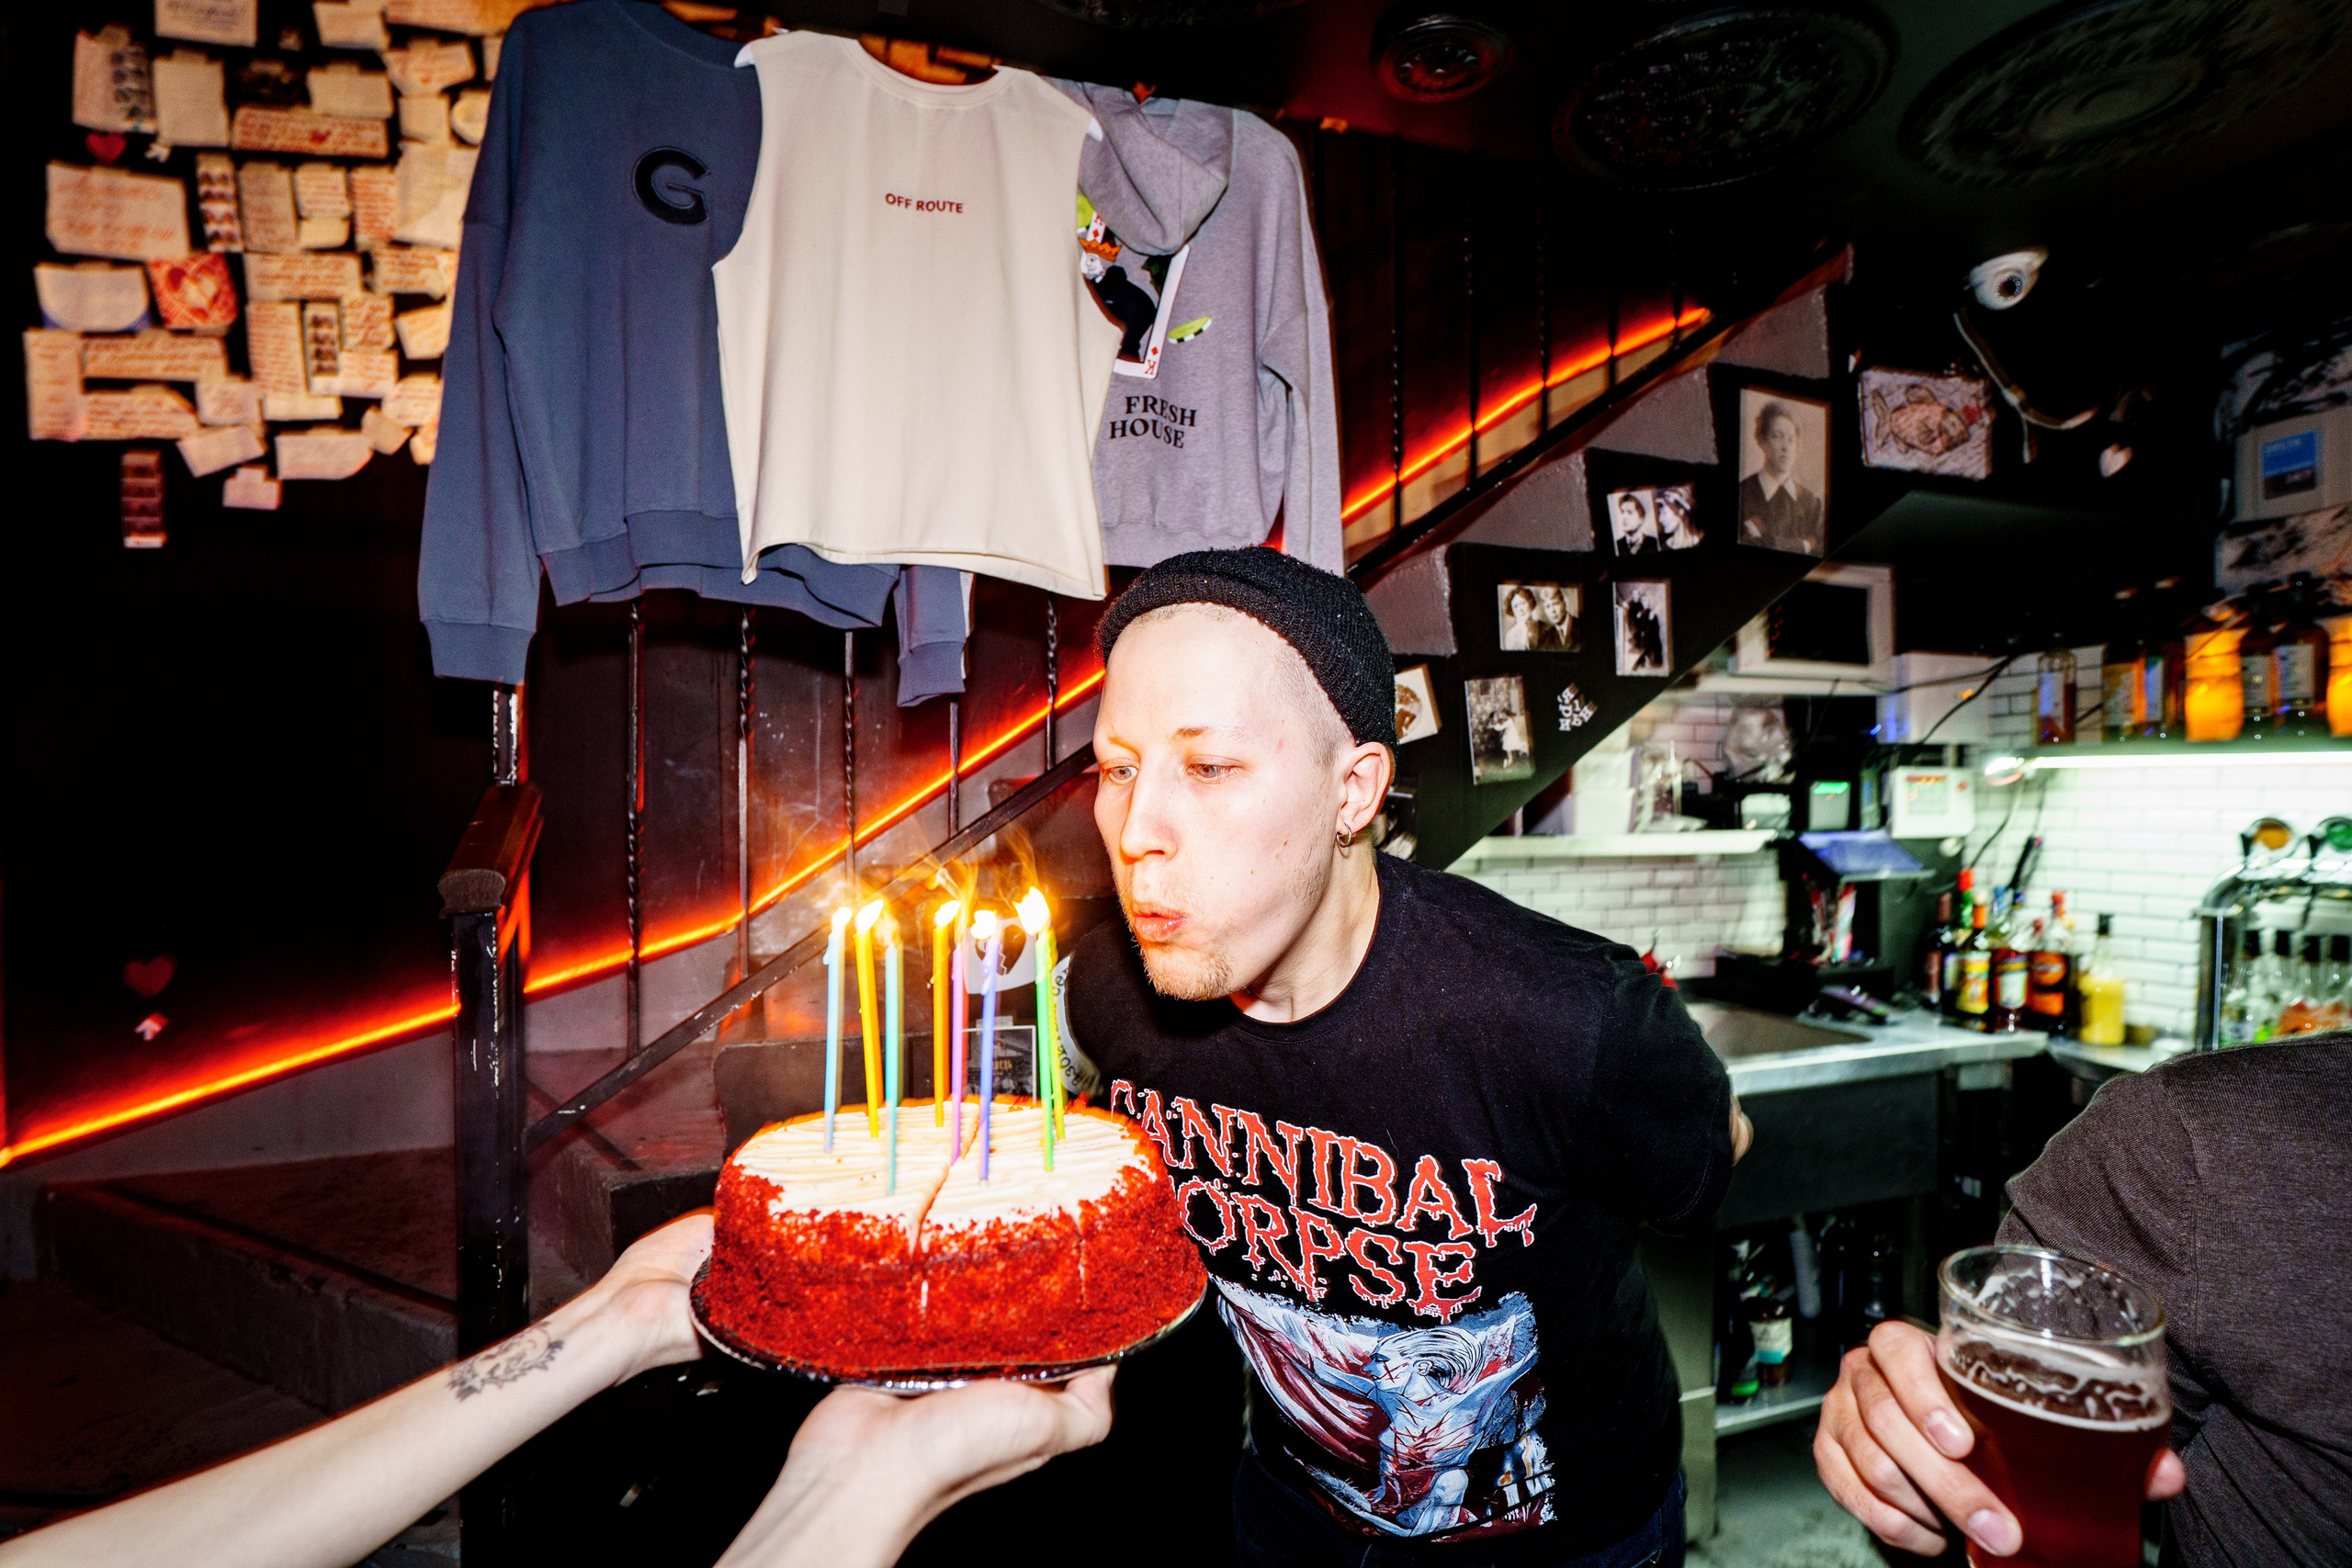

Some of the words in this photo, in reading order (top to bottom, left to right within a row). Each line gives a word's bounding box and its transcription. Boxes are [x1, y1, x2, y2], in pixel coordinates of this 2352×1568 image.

[631, 145, 710, 226] G
[885, 193, 911, 209] OFF
[916, 199, 964, 214] ROUTE
[1125, 395, 1197, 427] FRESH
[1109, 417, 1185, 449] HOUSE
[1170, 1174, 1481, 1324] ORPSE
